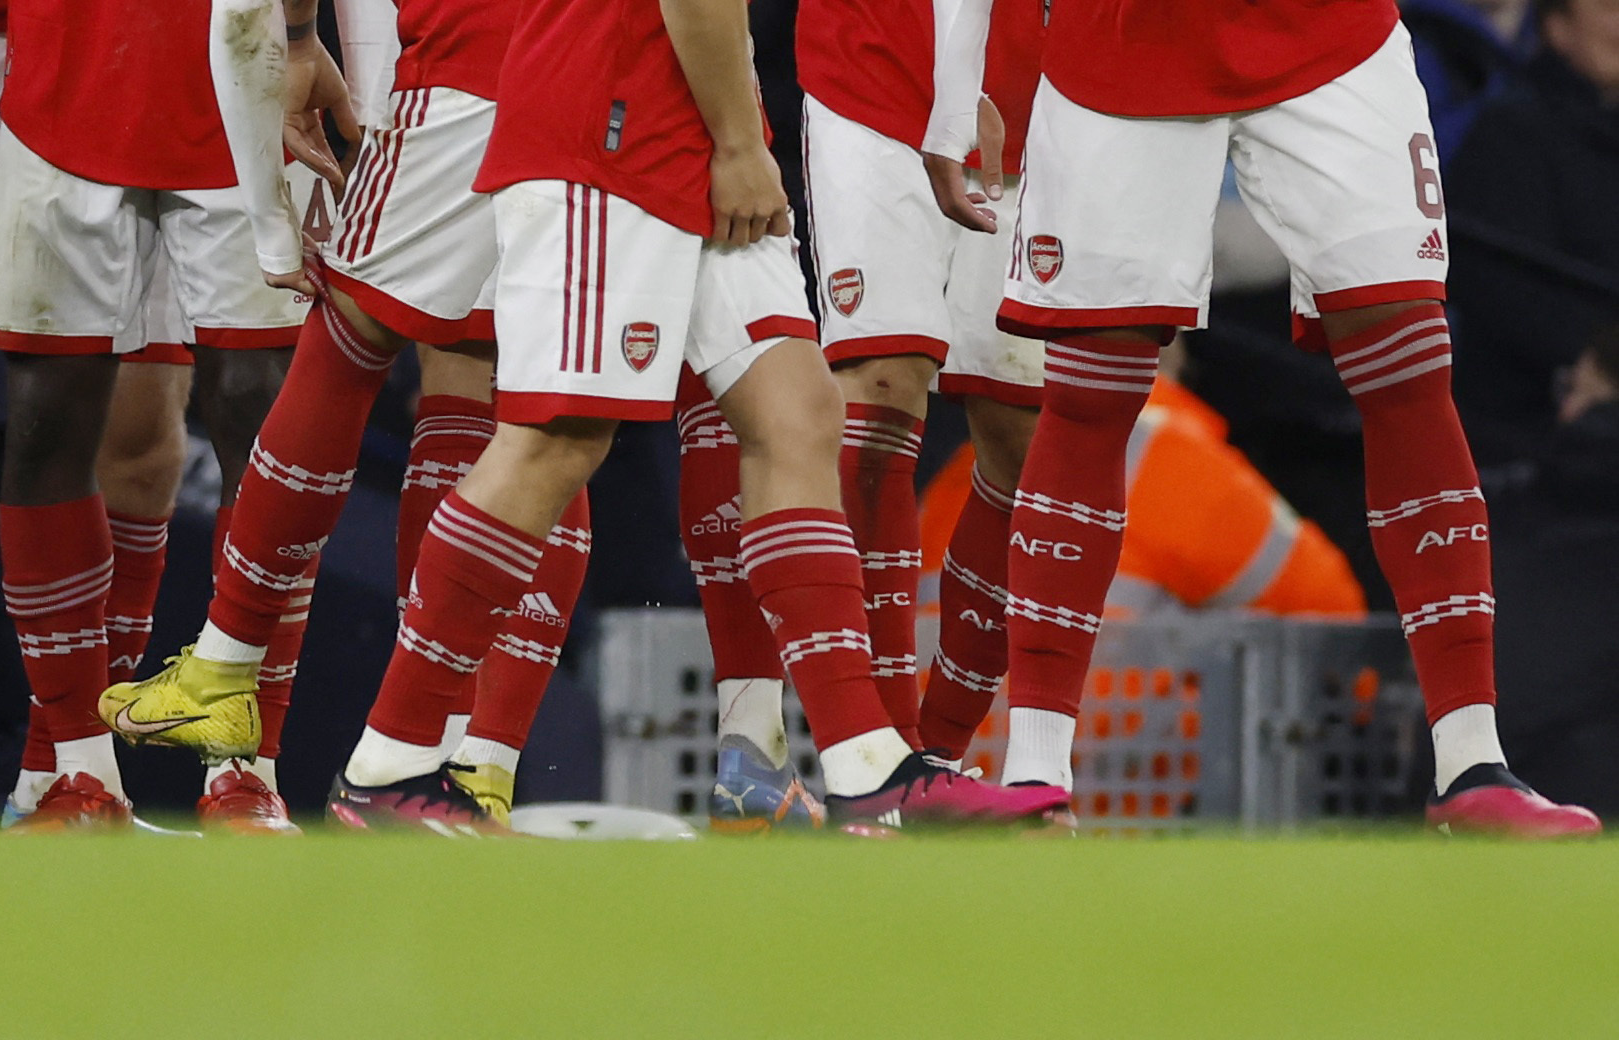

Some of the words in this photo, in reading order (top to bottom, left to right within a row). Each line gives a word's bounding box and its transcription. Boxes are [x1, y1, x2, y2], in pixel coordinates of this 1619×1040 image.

[1408, 132, 1444, 220] 6
[1009, 530, 1083, 560] AFC
[1415, 523, 1488, 554] AFC
